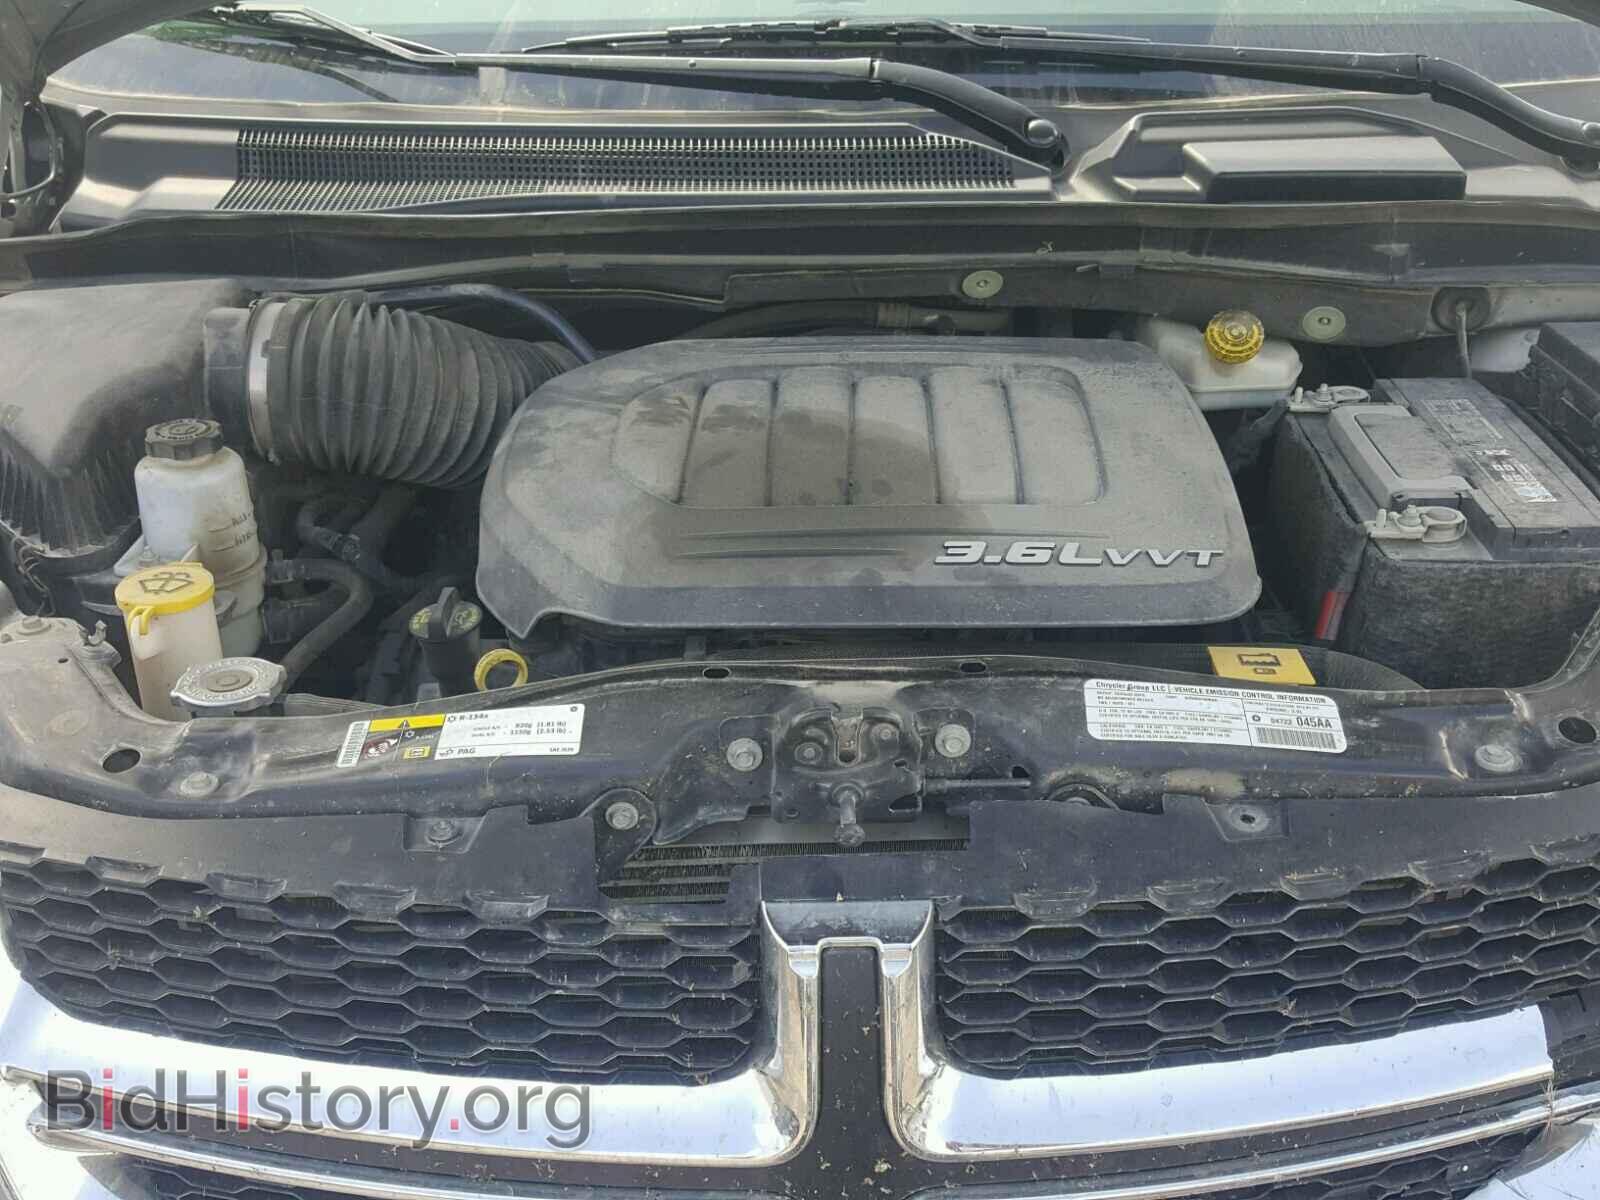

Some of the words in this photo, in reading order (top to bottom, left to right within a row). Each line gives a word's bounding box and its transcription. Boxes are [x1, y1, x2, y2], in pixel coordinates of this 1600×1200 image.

[1095, 681, 1126, 690] Chrysler
[1127, 683, 1150, 692] Group
[1174, 686, 1203, 695] VEHICLE
[1205, 688, 1240, 697] EMISSION
[1241, 691, 1275, 700] CONTROL
[1275, 694, 1327, 704] INFORMATION
[1296, 716, 1333, 729] 045AA
